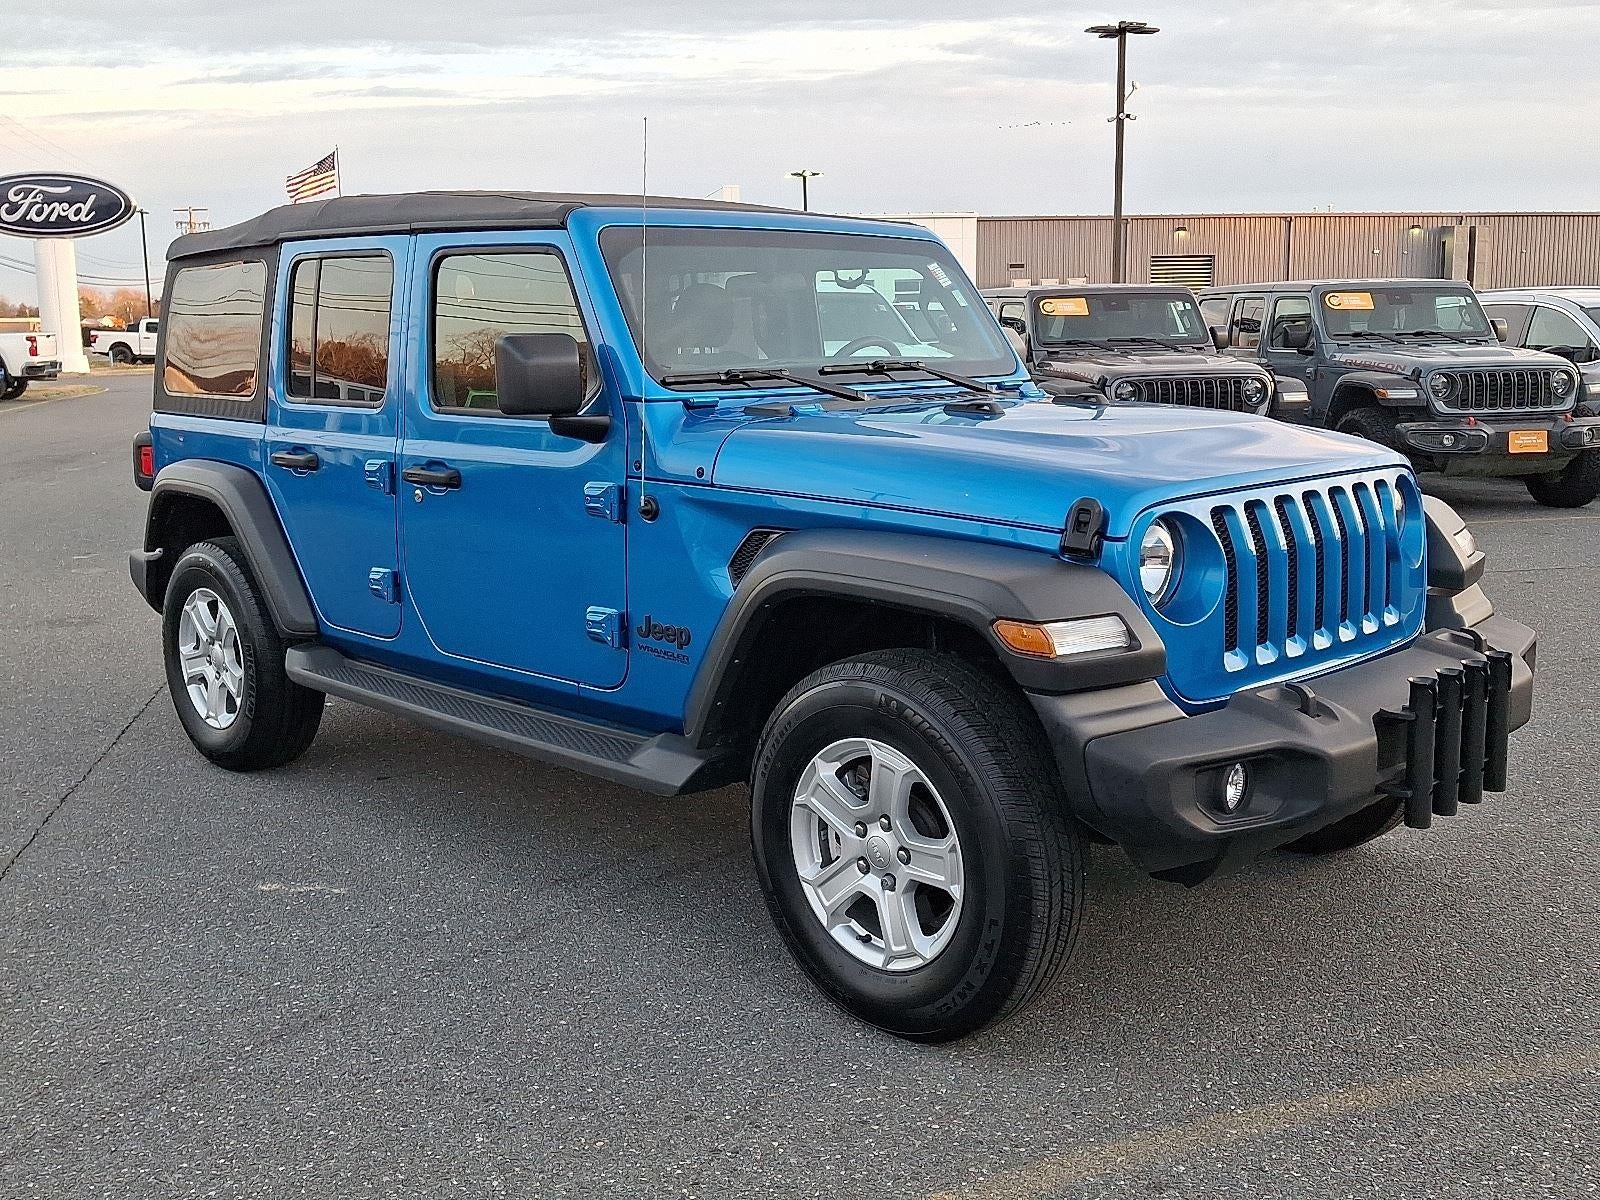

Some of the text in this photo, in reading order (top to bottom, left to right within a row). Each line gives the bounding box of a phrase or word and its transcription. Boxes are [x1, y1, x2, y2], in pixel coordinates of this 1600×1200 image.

[0, 184, 97, 223] Ford
[637, 614, 692, 650] Jeep
[637, 643, 690, 662] WRANGLER
